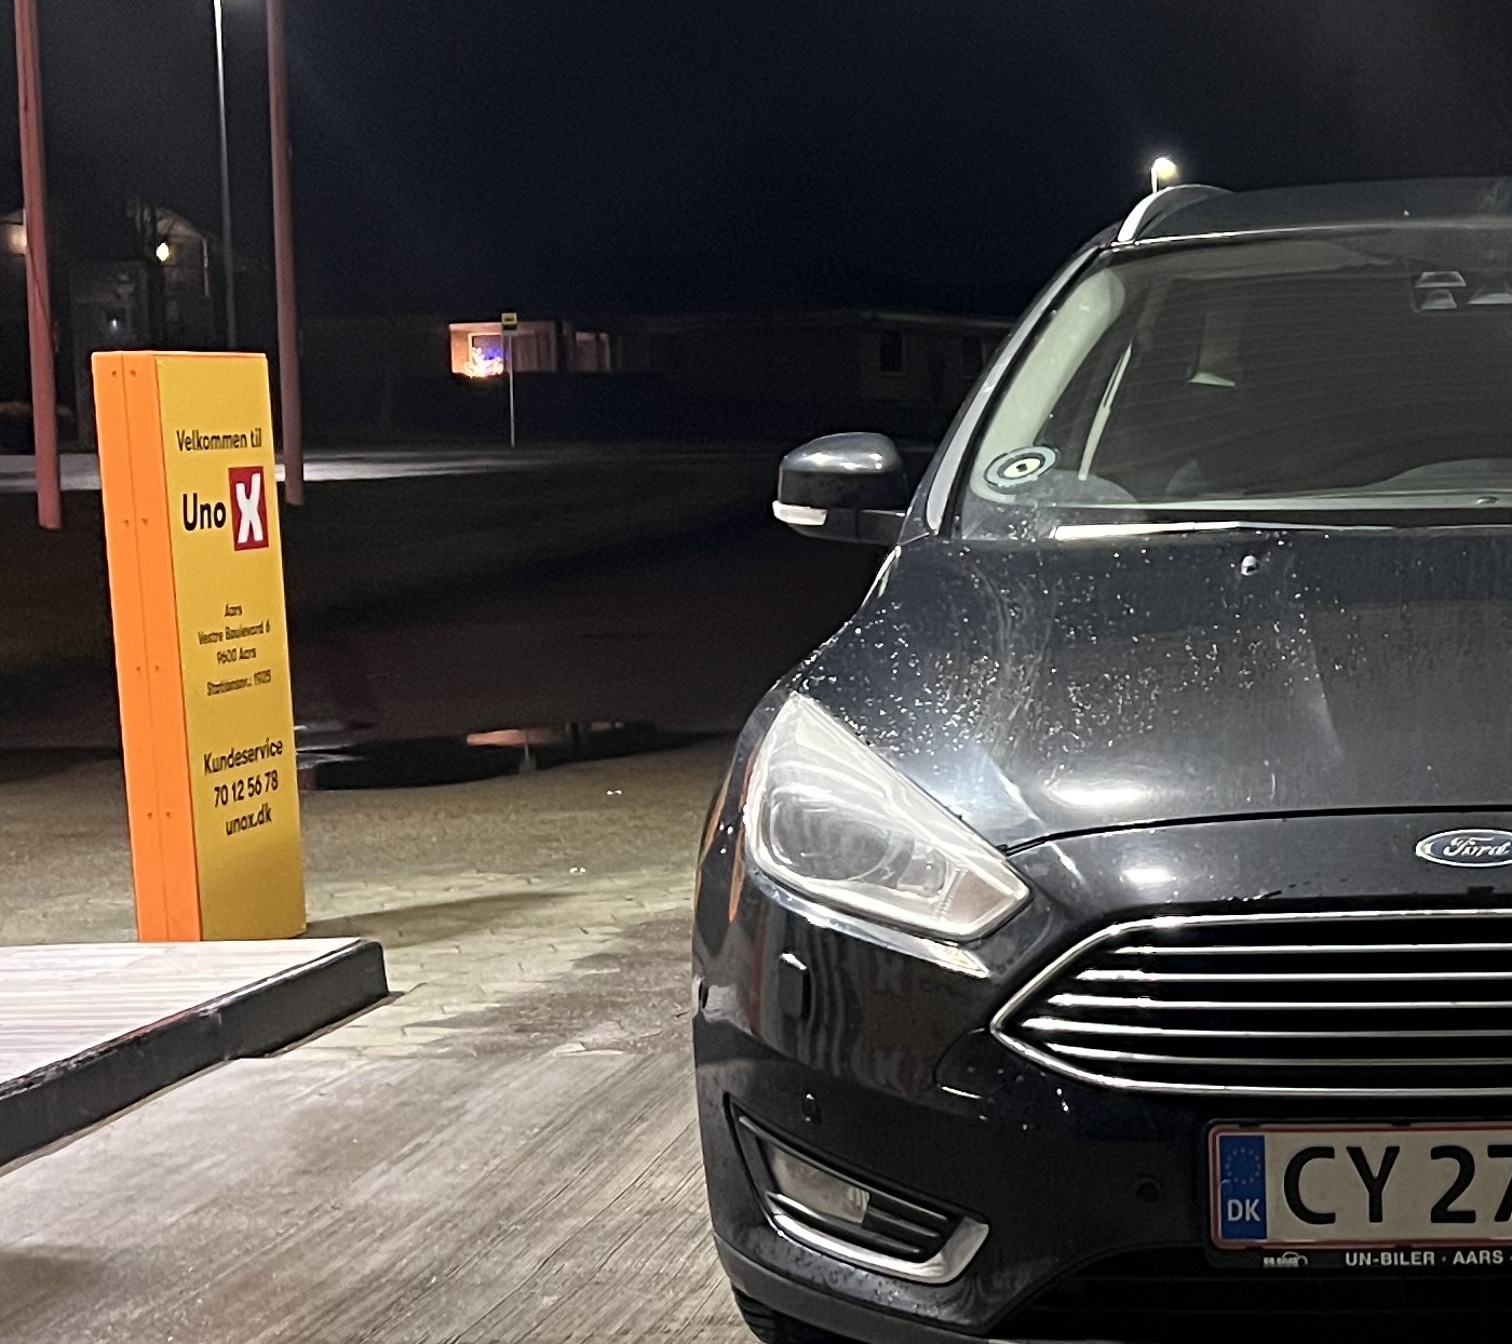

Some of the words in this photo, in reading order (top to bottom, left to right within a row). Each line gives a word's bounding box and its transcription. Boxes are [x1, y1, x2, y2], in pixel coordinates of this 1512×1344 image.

[176, 429, 248, 452] Velkommen
[250, 427, 262, 448] til
[183, 492, 226, 532] Uno
[235, 472, 264, 544] X
[203, 737, 283, 776] Kundeservice
[214, 784, 229, 808] 70
[231, 779, 245, 803] 12
[247, 774, 262, 798] 56
[264, 769, 279, 793] 78
[225, 802, 272, 836] unox.dk
[1443, 835, 1512, 857] Ford
[1283, 1144, 1401, 1225] CY
[1227, 1198, 1261, 1223] DK
[1345, 1250, 1436, 1267] UN-BILER
[1452, 1249, 1504, 1265] AARS
